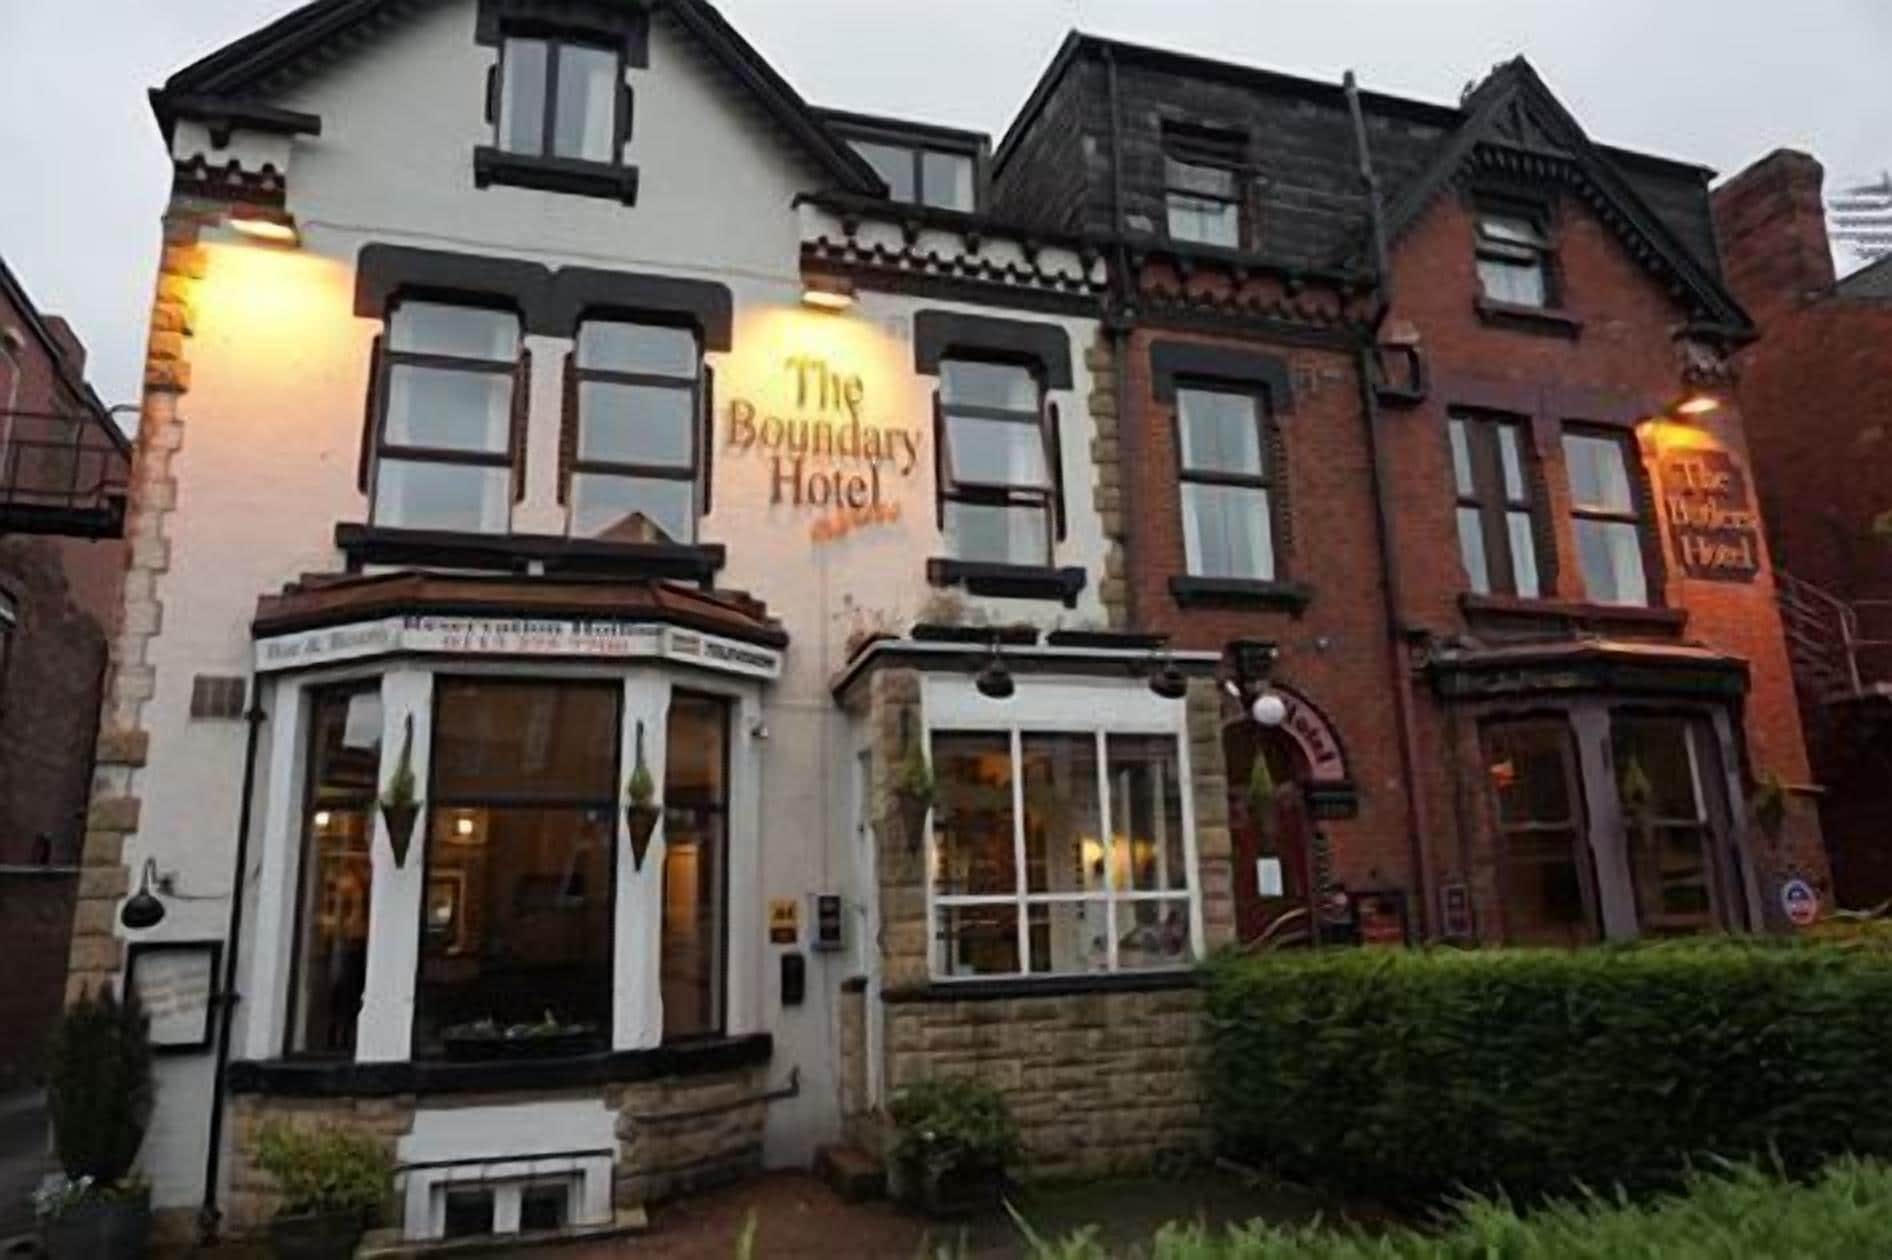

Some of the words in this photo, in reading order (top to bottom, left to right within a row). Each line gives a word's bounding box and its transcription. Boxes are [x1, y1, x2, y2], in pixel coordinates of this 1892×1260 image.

[785, 355, 864, 410] The
[728, 398, 922, 476] Boundary
[770, 455, 880, 509] Hotel
[1671, 459, 1730, 492] The
